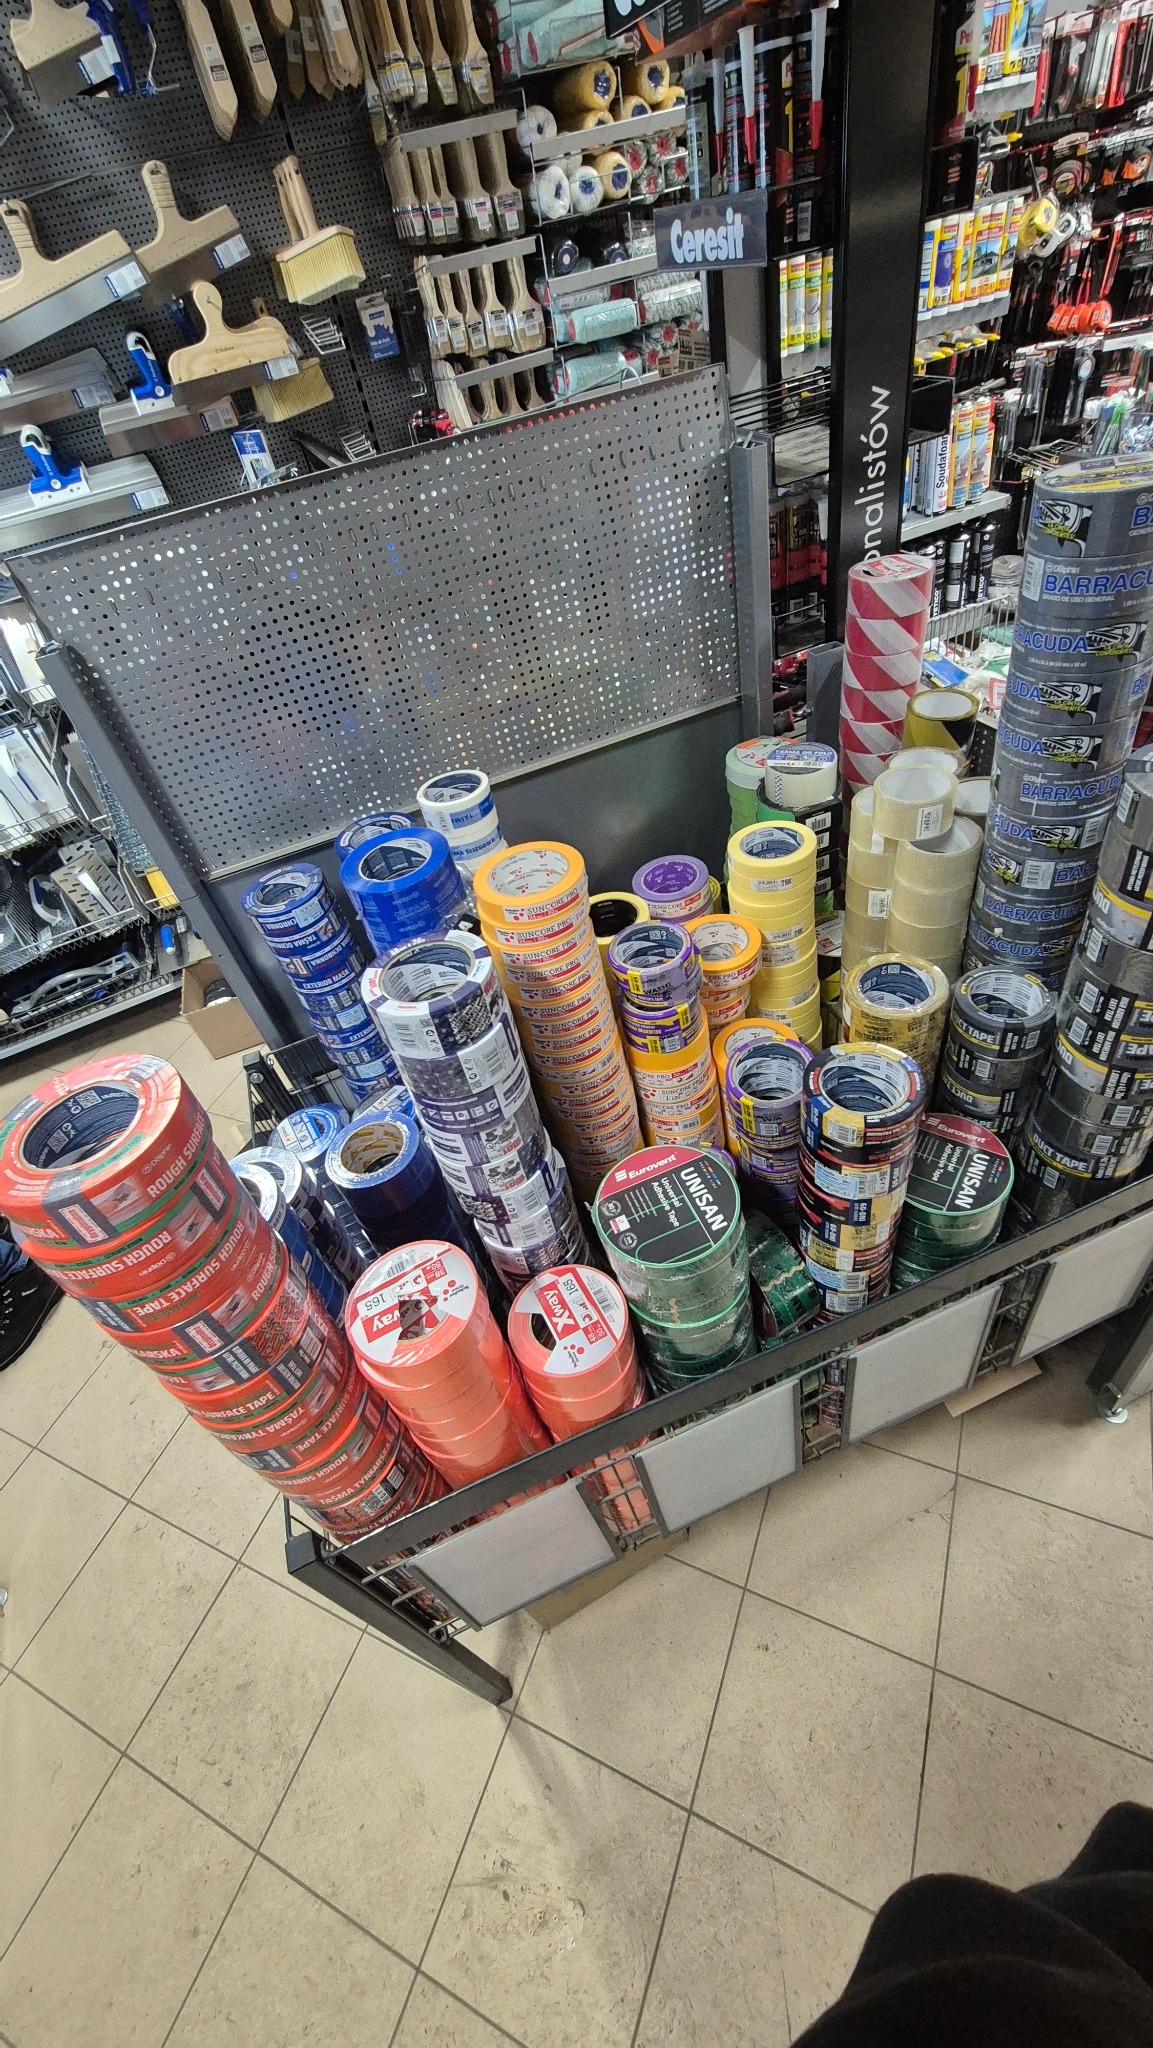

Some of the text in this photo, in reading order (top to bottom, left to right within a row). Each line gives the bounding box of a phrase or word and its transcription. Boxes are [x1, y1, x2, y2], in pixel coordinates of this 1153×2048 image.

[671, 207, 744, 264] Ceresit
[1044, 568, 1153, 596] BARRACU
[1021, 774, 1121, 801] BARRACUD
[527, 888, 579, 915] SUNCORE PRO
[1092, 884, 1110, 914] DUC
[266, 919, 297, 930] CHRONNA
[517, 918, 572, 938] SUNCORE PRO
[295, 934, 317, 948] TAŚMA
[523, 937, 575, 960] SUNCORE PRO
[303, 968, 351, 990] EXTERIOR MASK
[526, 957, 579, 978] SUNCORE PRO
[541, 970, 590, 995] SUNCORE PRO
[643, 982, 672, 996] WASHI
[540, 993, 590, 1014] SUNCORE PRO
[1104, 1008, 1116, 1021] TEAR
[551, 1006, 599, 1030] SUNCORE PRO
[553, 1025, 600, 1046] SUNCORE PRO
[967, 1026, 995, 1044] TAPE
[552, 1043, 600, 1063] SUNCORE PRO
[661, 1086, 692, 1096] SUNCORE
[937, 1123, 987, 1144] Eurovent
[946, 1146, 964, 1173] Universal
[1033, 1133, 1088, 1171] DUCT TAPE
[146, 1156, 187, 1198] ROUGH
[628, 1152, 678, 1180] Eurovent
[931, 1168, 944, 1182] Tape
[661, 1177, 683, 1208] Universal
[954, 1153, 991, 1209] UNISAN
[651, 1181, 680, 1228] Adhesive Tape
[680, 1166, 728, 1232] UNISAN
[68, 1208, 101, 1241] Oryginalna
[66, 1230, 173, 1280] ROUGH SURFACE
[132, 1221, 245, 1317] ROUGH SURFACE TAPE
[251, 1262, 275, 1302] ROUGH
[563, 1278, 579, 1296] 165
[365, 1293, 387, 1312] 165
[544, 1289, 576, 1334] Xway
[372, 1309, 400, 1333] way
[249, 1391, 275, 1410] TAPE
[266, 1407, 306, 1434] TAŚMA
[295, 1395, 351, 1452] SURFACE TAPE
[316, 1453, 348, 1479] ROUGH
[320, 1441, 392, 1506] TAŚMA TYNKARSKA
